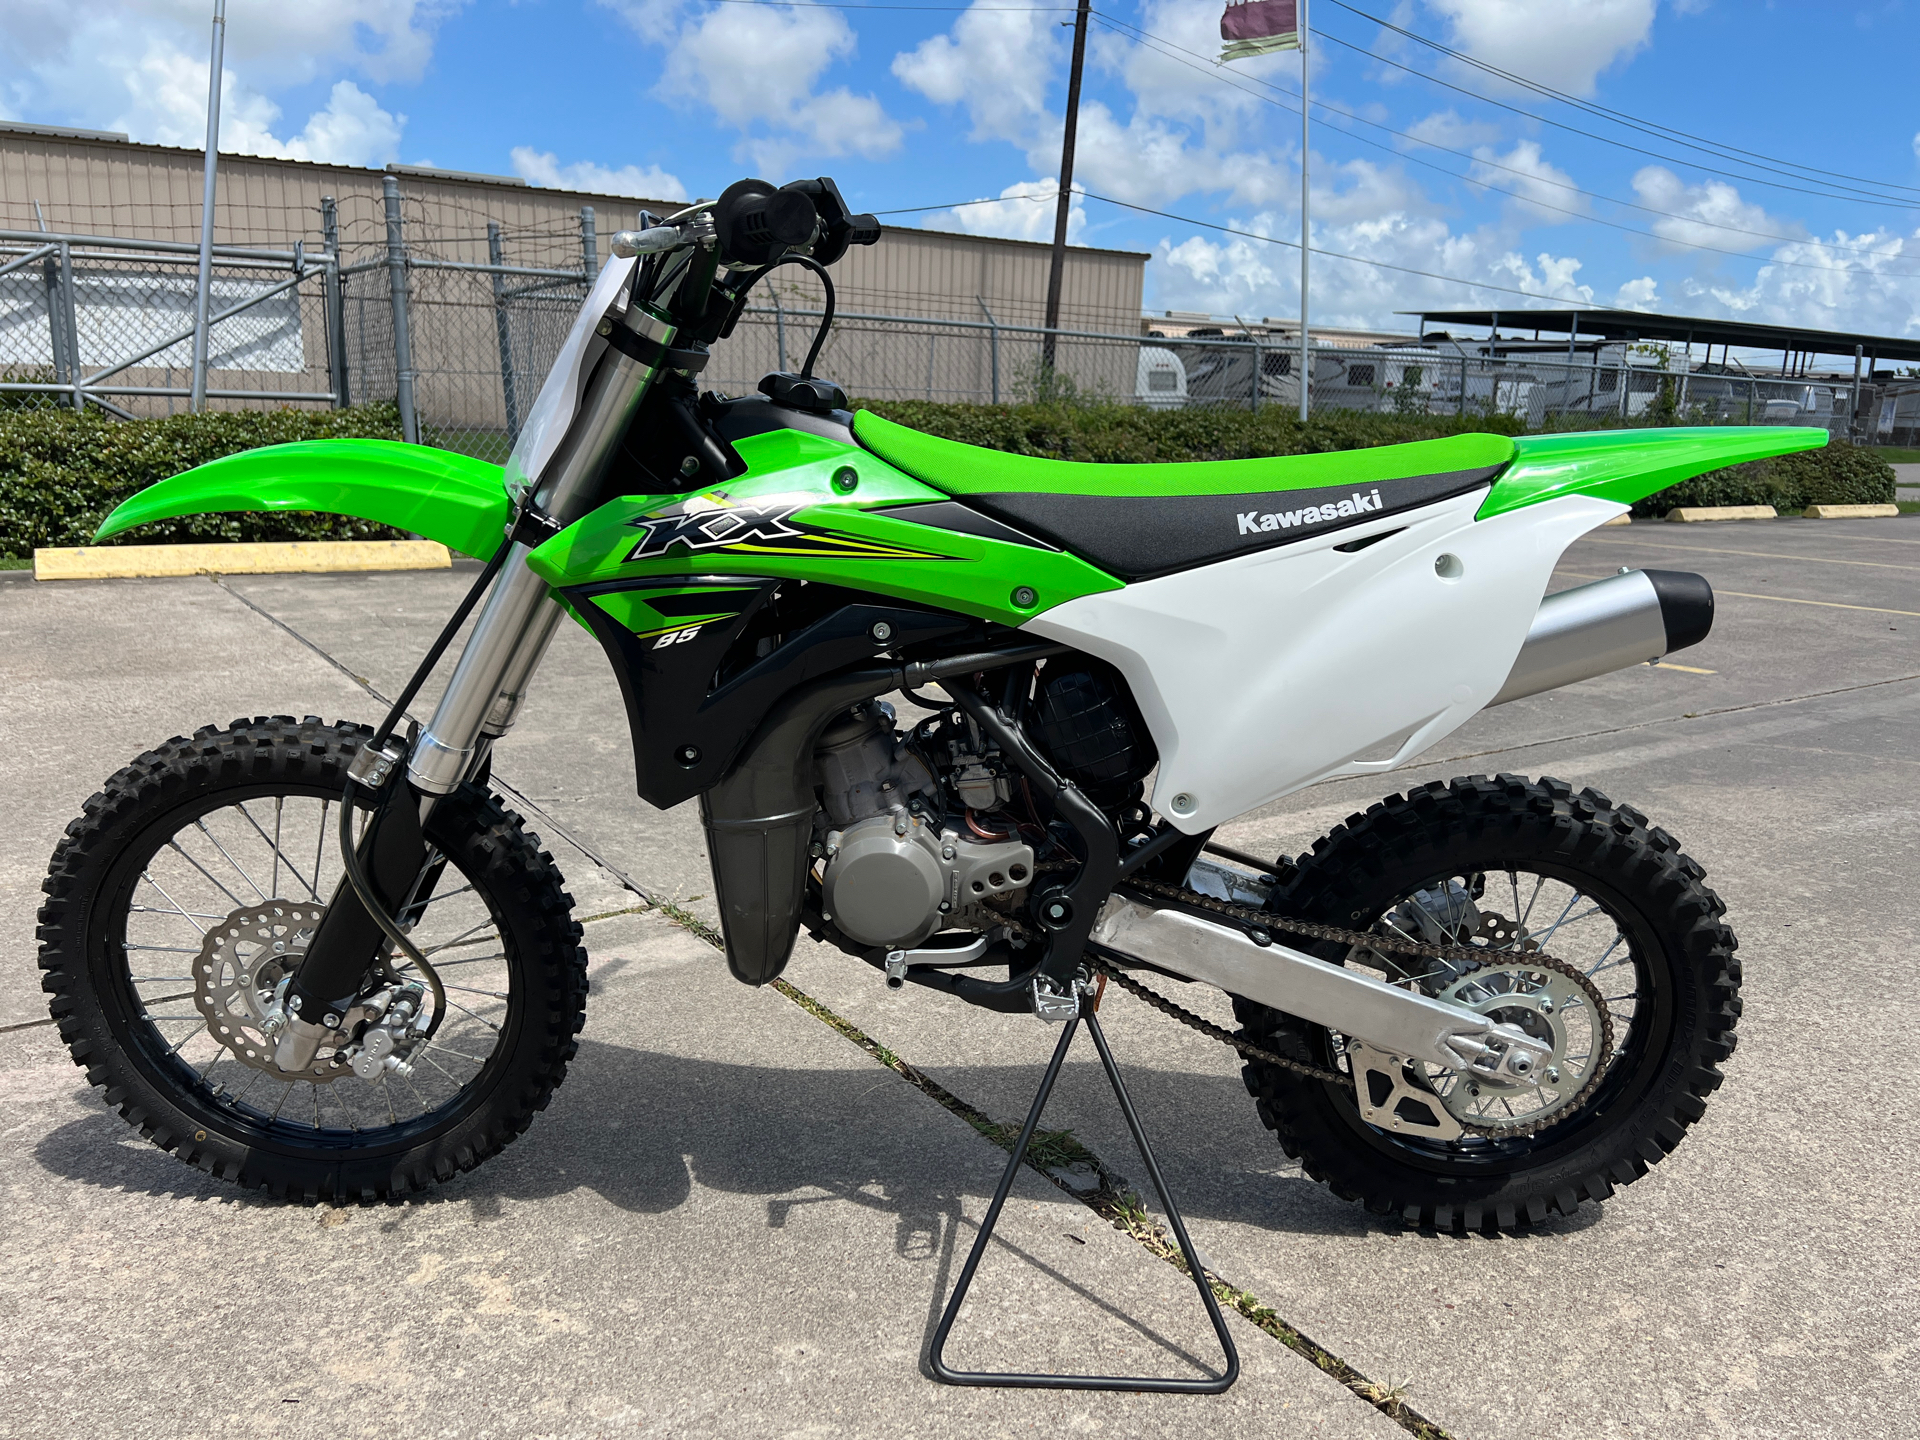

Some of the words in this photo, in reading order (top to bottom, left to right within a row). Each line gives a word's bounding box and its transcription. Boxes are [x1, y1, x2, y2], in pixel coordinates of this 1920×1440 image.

[629, 503, 806, 560] KX
[1236, 489, 1383, 535] Kawasaki
[652, 626, 702, 650] 85
